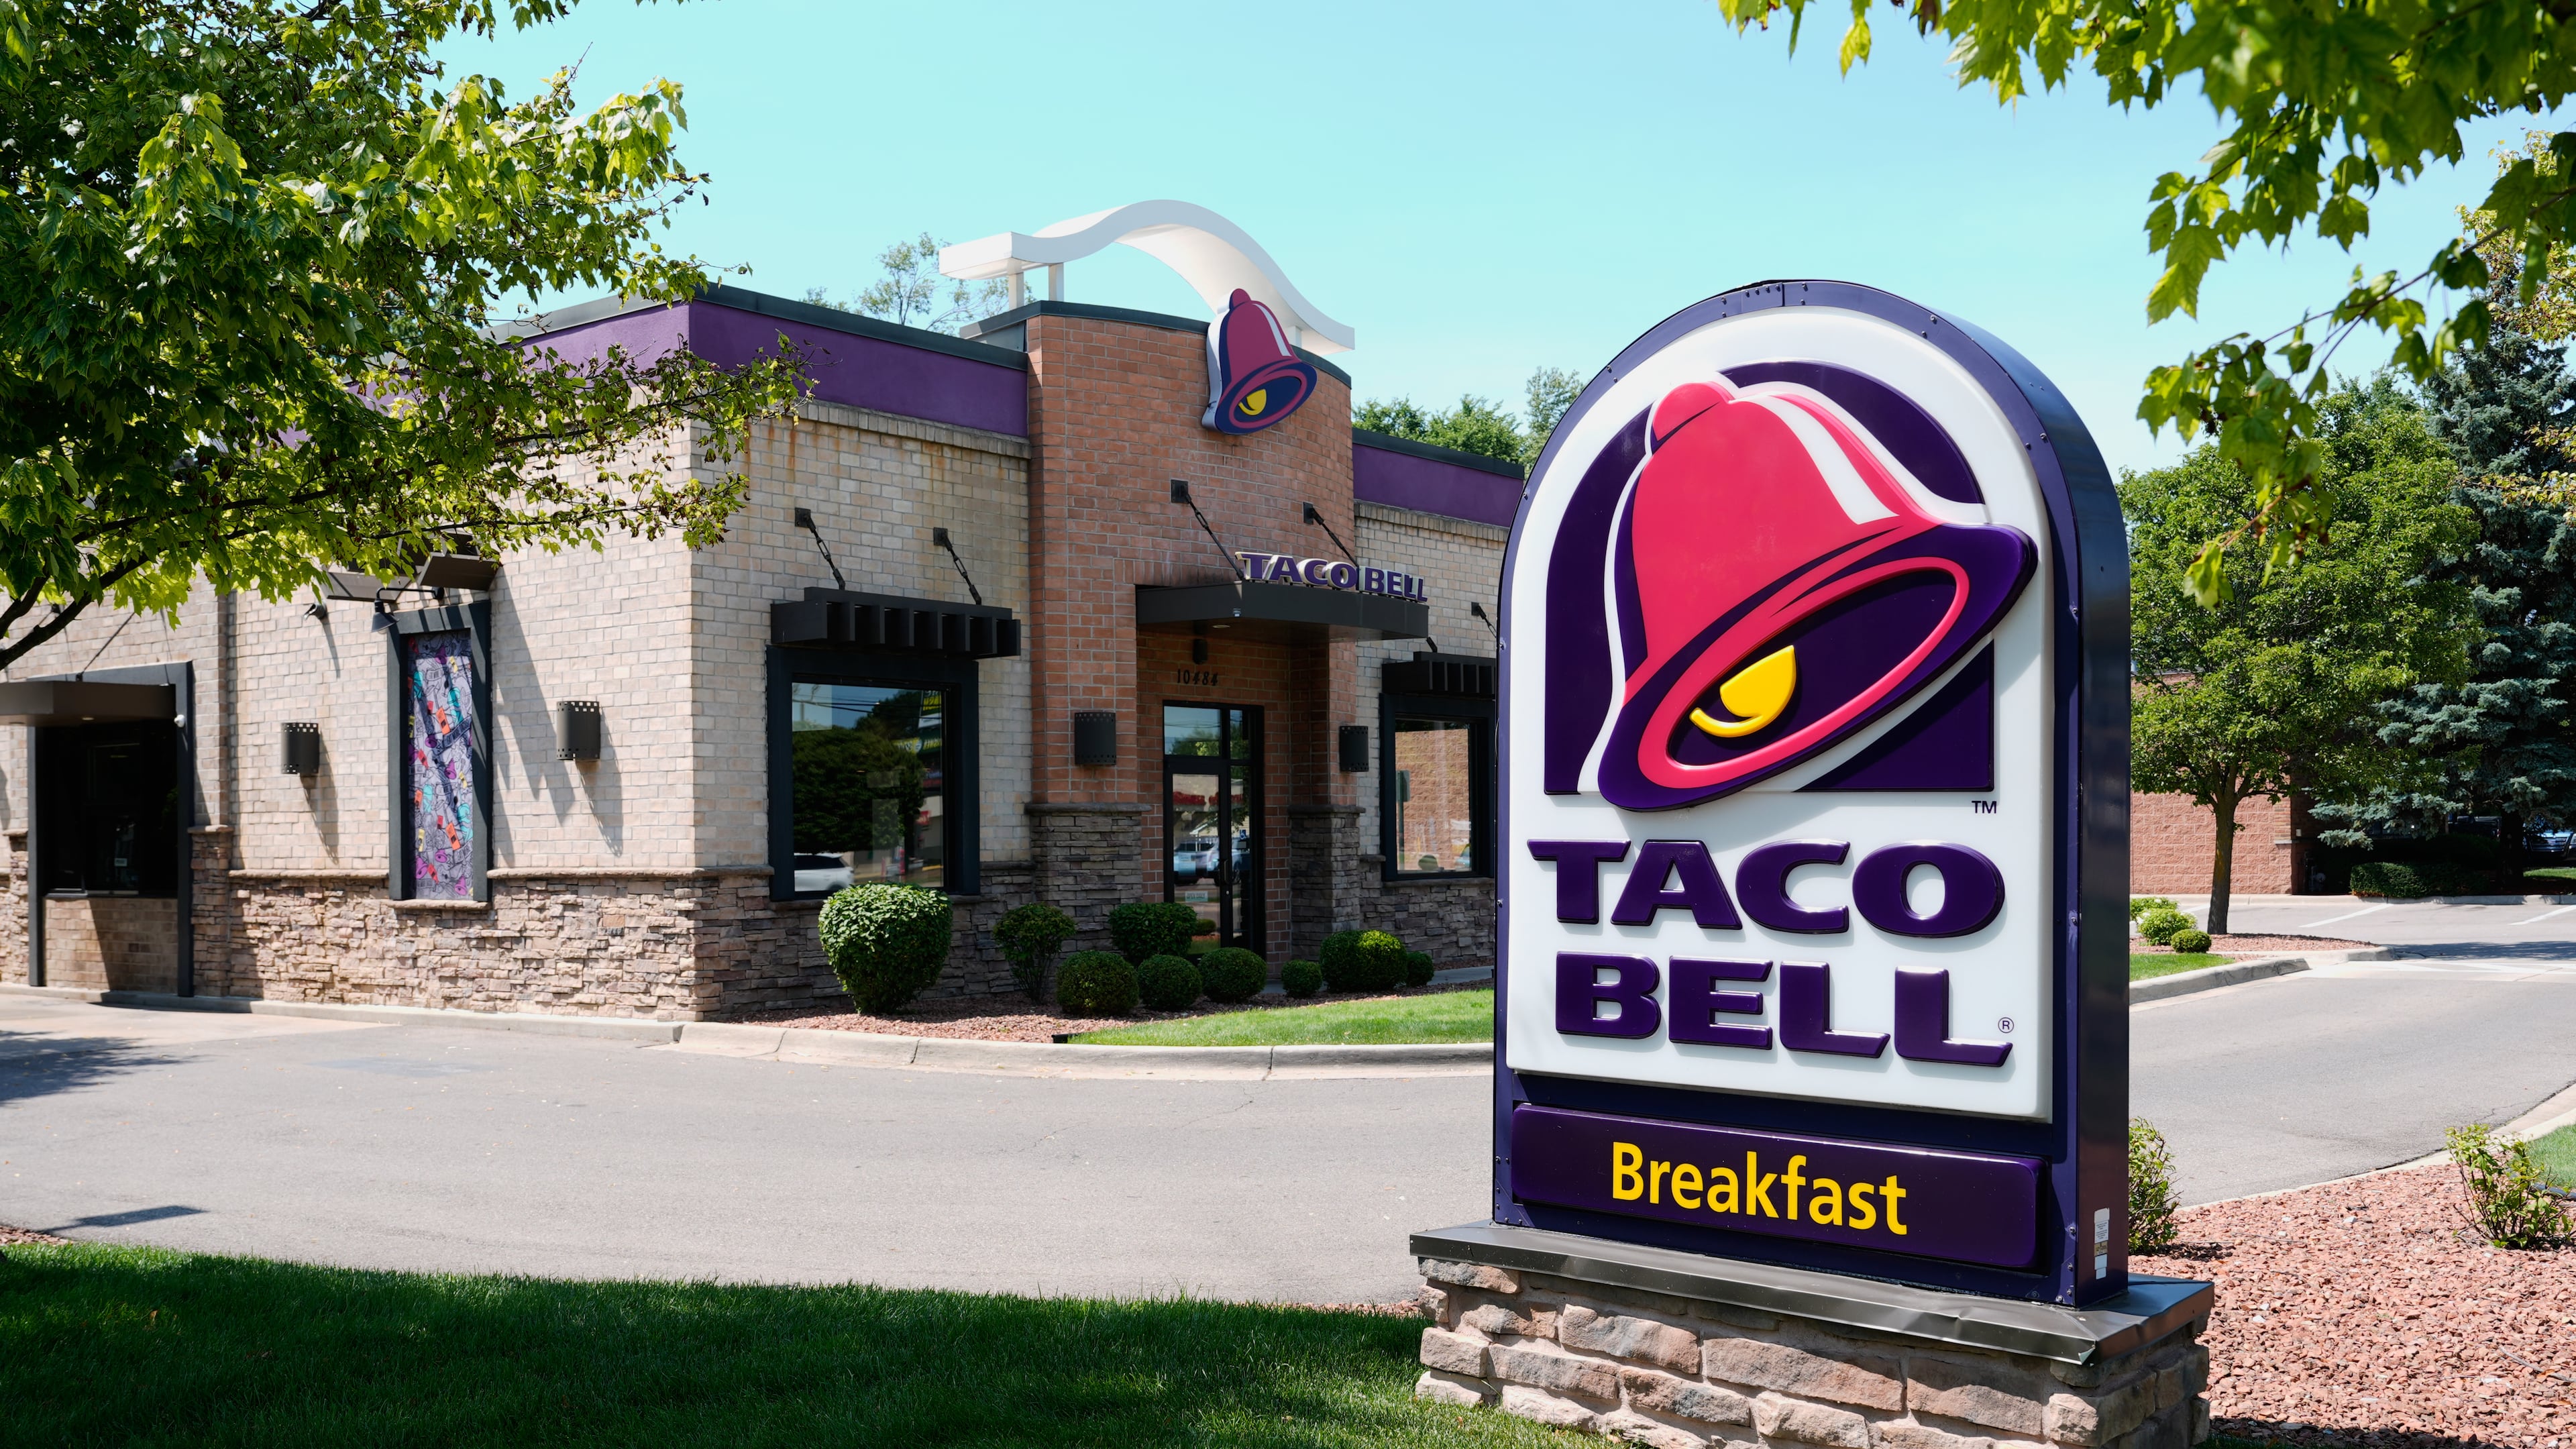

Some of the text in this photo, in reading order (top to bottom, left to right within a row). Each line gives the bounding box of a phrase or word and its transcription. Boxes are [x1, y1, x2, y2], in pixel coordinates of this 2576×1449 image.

[1234, 551, 1428, 602] TACO BELL
[1177, 669, 1218, 686] 10484
[1972, 800, 1997, 814] TM
[1527, 839, 2006, 938] TACO
[1556, 951, 2013, 1068] BELL
[1611, 1141, 1908, 1236] Breakfast
